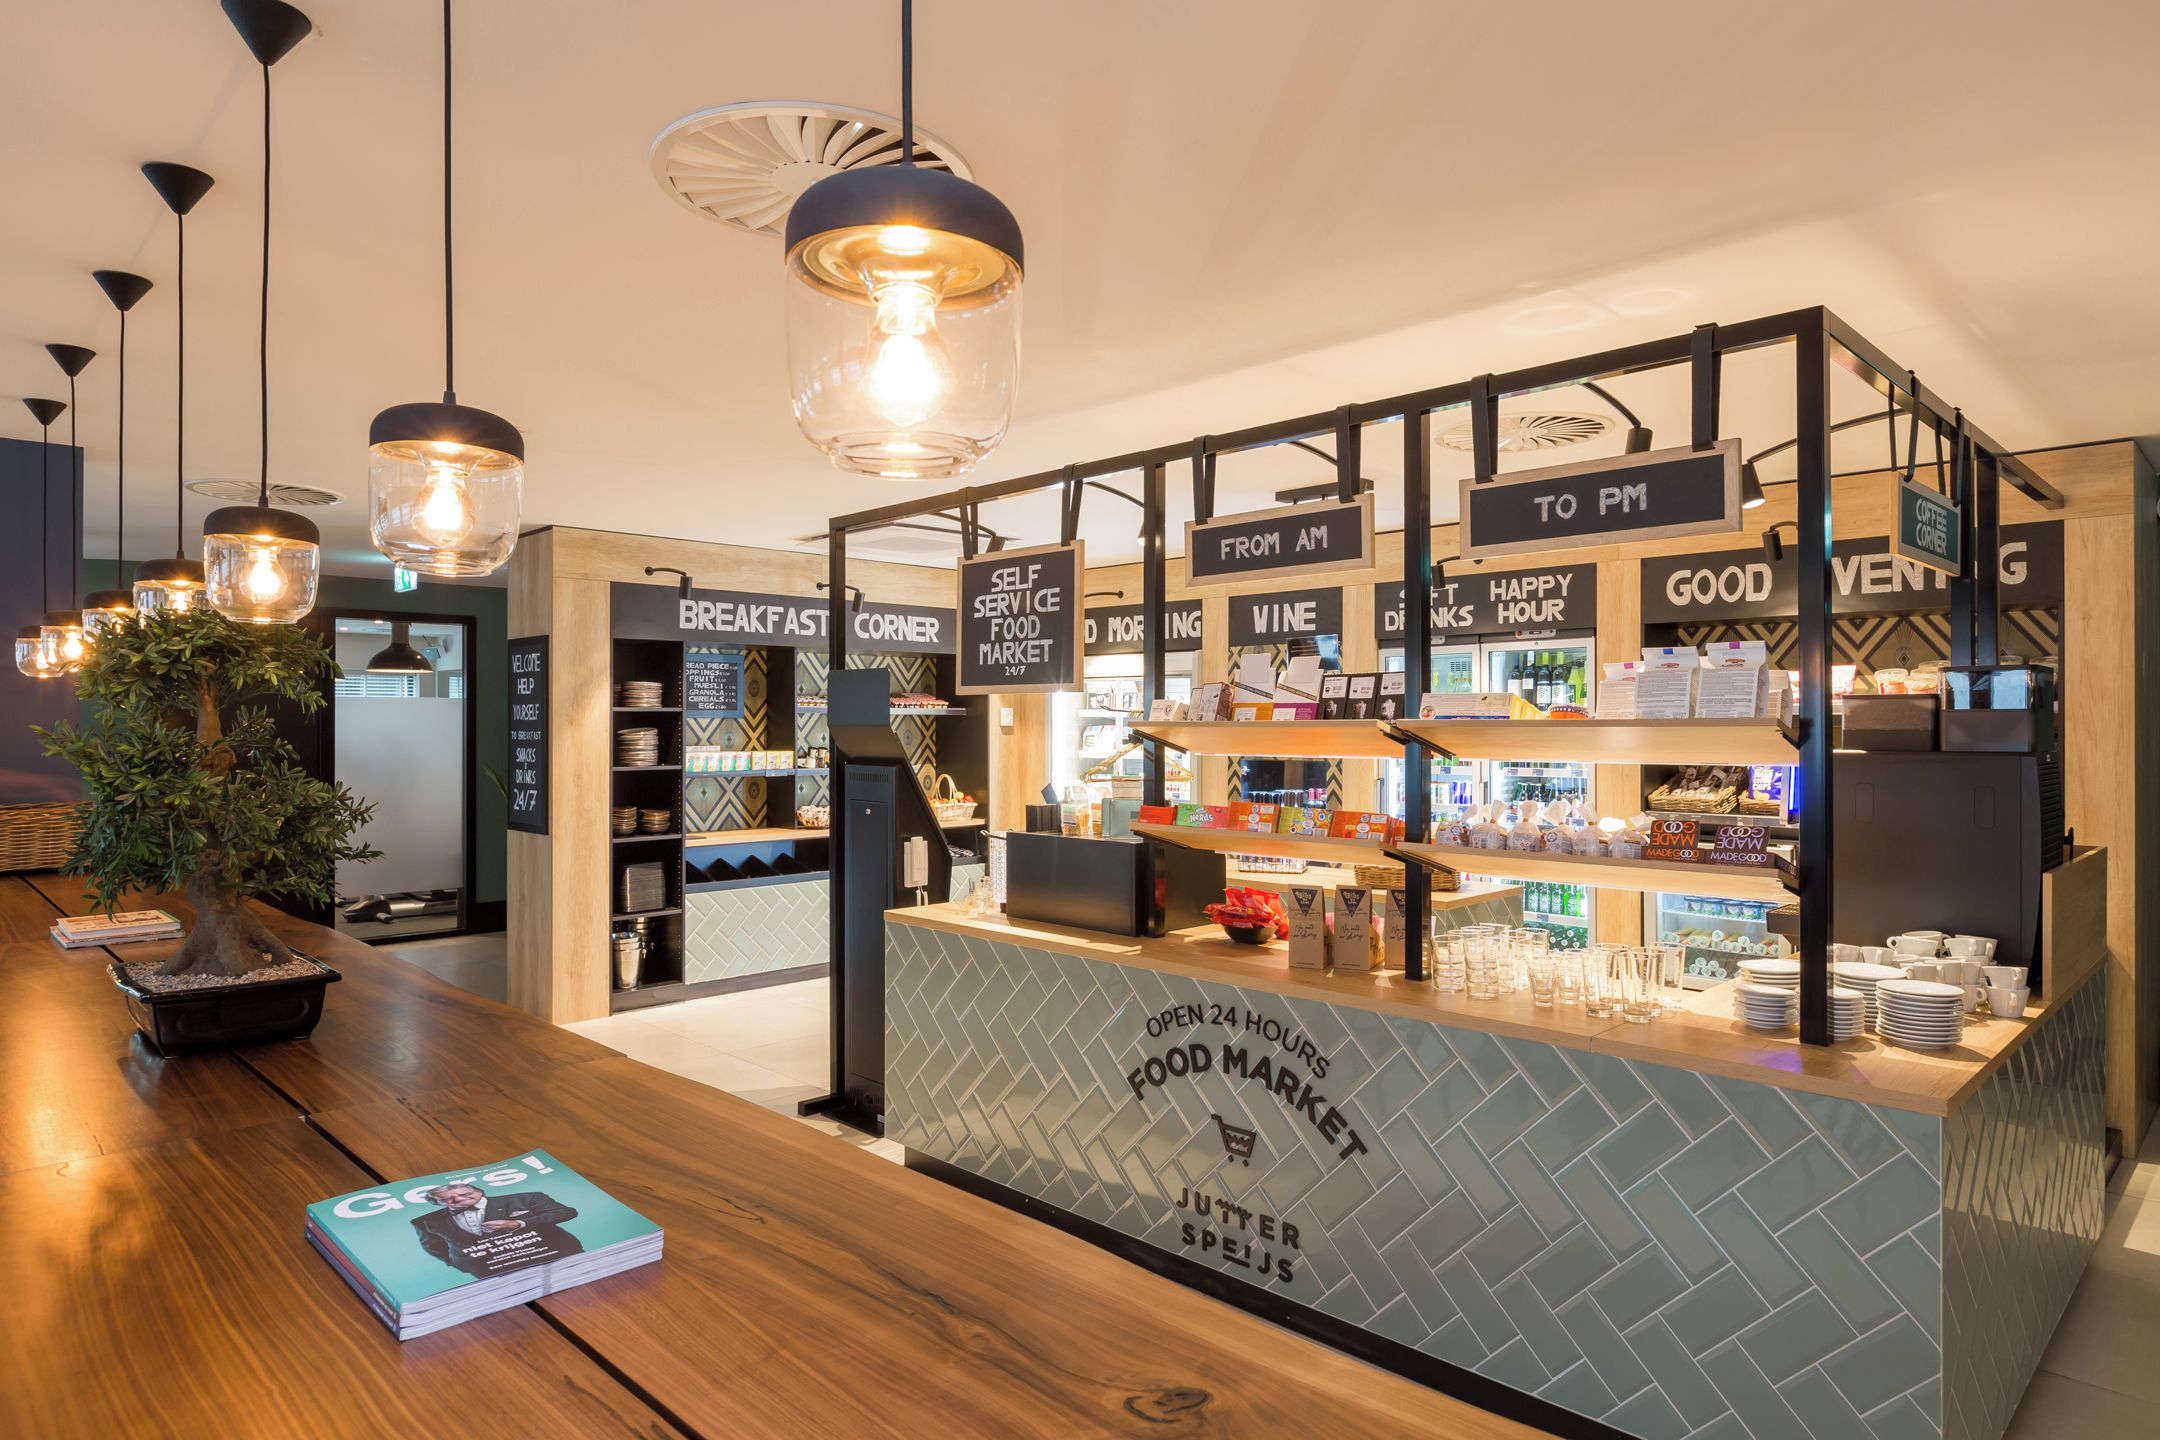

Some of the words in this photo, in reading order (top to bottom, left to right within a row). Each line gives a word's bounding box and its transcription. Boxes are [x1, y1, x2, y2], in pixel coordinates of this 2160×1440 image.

[1534, 493, 1577, 522] TO
[1599, 482, 1647, 516] PM
[1915, 498, 1947, 532] COFFEE
[1220, 531, 1280, 560] FROM
[1295, 525, 1328, 552] AM
[1916, 522, 1947, 556] CORNER
[991, 564, 1042, 593] SELF
[1665, 562, 1773, 606] GOOD
[1831, 541, 2028, 596] VENG
[1490, 573, 1573, 602] HAPPY
[974, 587, 1061, 618] SERVICE
[1497, 599, 1565, 625] HOUR
[679, 599, 830, 637] BREAKFAST
[854, 612, 940, 644] CORNER
[990, 615, 1041, 641] FOOD
[1107, 610, 1202, 643] MORING
[1253, 601, 1317, 634] WINE
[1384, 605, 1474, 632] DNKS
[979, 639, 1054, 665] MARKET
[1005, 665, 1027, 676] 24/7
[517, 678, 535, 695] HELP
[513, 703, 540, 721] YOURSELF
[511, 730, 518, 740] TO
[518, 730, 541, 741] BREAKFAST
[516, 747, 536, 763] SNACKS
[515, 769, 536, 785] DRINKS
[513, 788, 538, 811] 24/7
[1652, 832, 1695, 847] MADE
[1653, 820, 1697, 834] GOOD
[1719, 826, 1765, 838] GOOD
[1646, 848, 1700, 859] MADEGOOD
[1716, 837, 1764, 851] MADE
[1710, 852, 1767, 863] MADEGOOD
[1146, 1004, 1204, 1038] OPEN
[1210, 1004, 1238, 1027] 24
[1245, 1010, 1330, 1079] HOURS
[1126, 1043, 1212, 1101] FOOD
[1223, 1044, 1369, 1161] MARKET
[1176, 1187, 1300, 1249] JUTTER
[488, 1236, 543, 1253] krijgen
[494, 1230, 538, 1246] kapot
